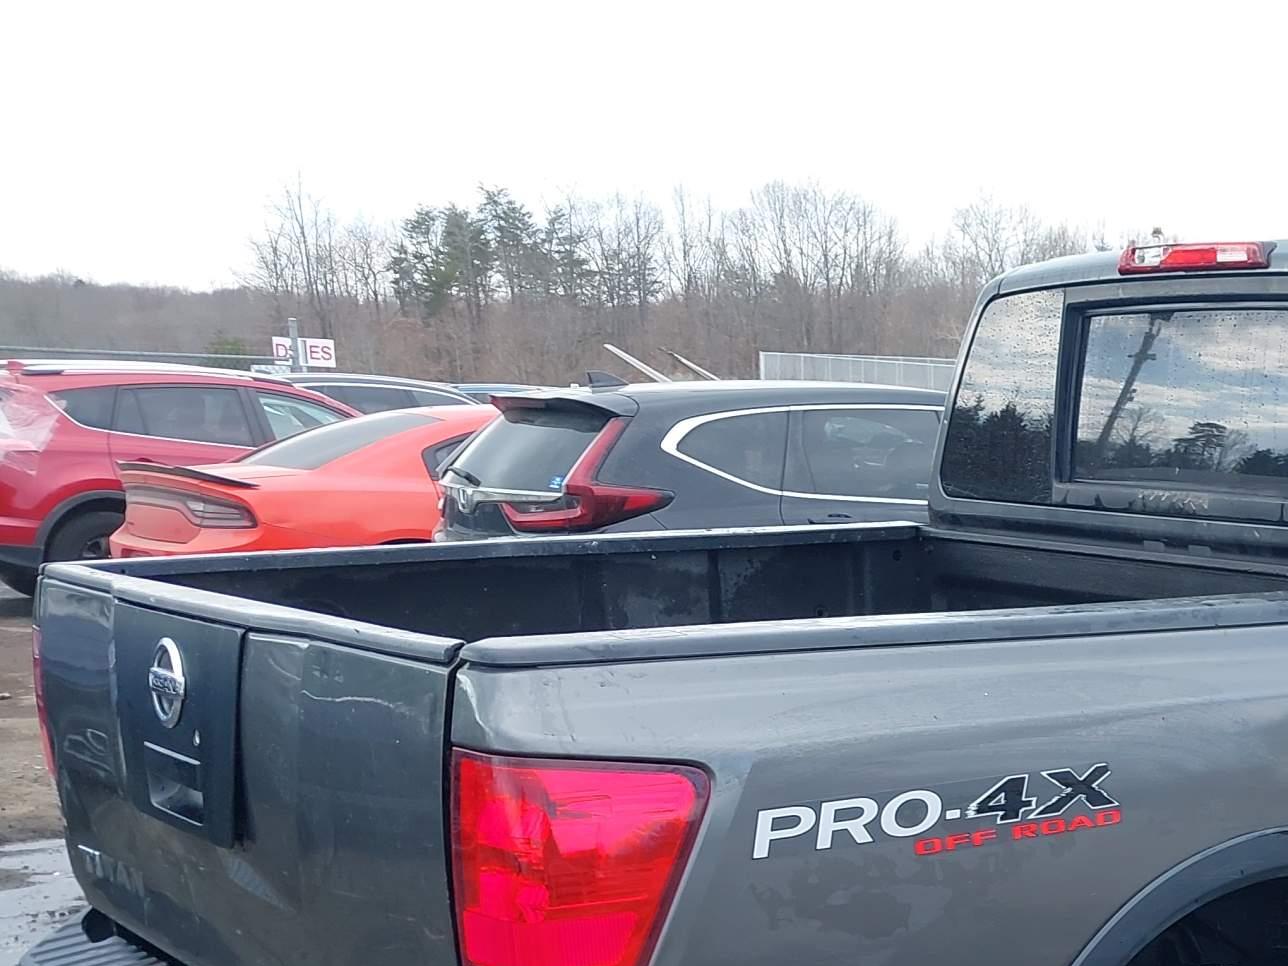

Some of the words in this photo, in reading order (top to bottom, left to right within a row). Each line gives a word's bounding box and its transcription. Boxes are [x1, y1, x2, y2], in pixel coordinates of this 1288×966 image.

[751, 763, 1121, 860] PRO-4X
[914, 829, 997, 857] OFF
[1011, 809, 1122, 841] ROAD
